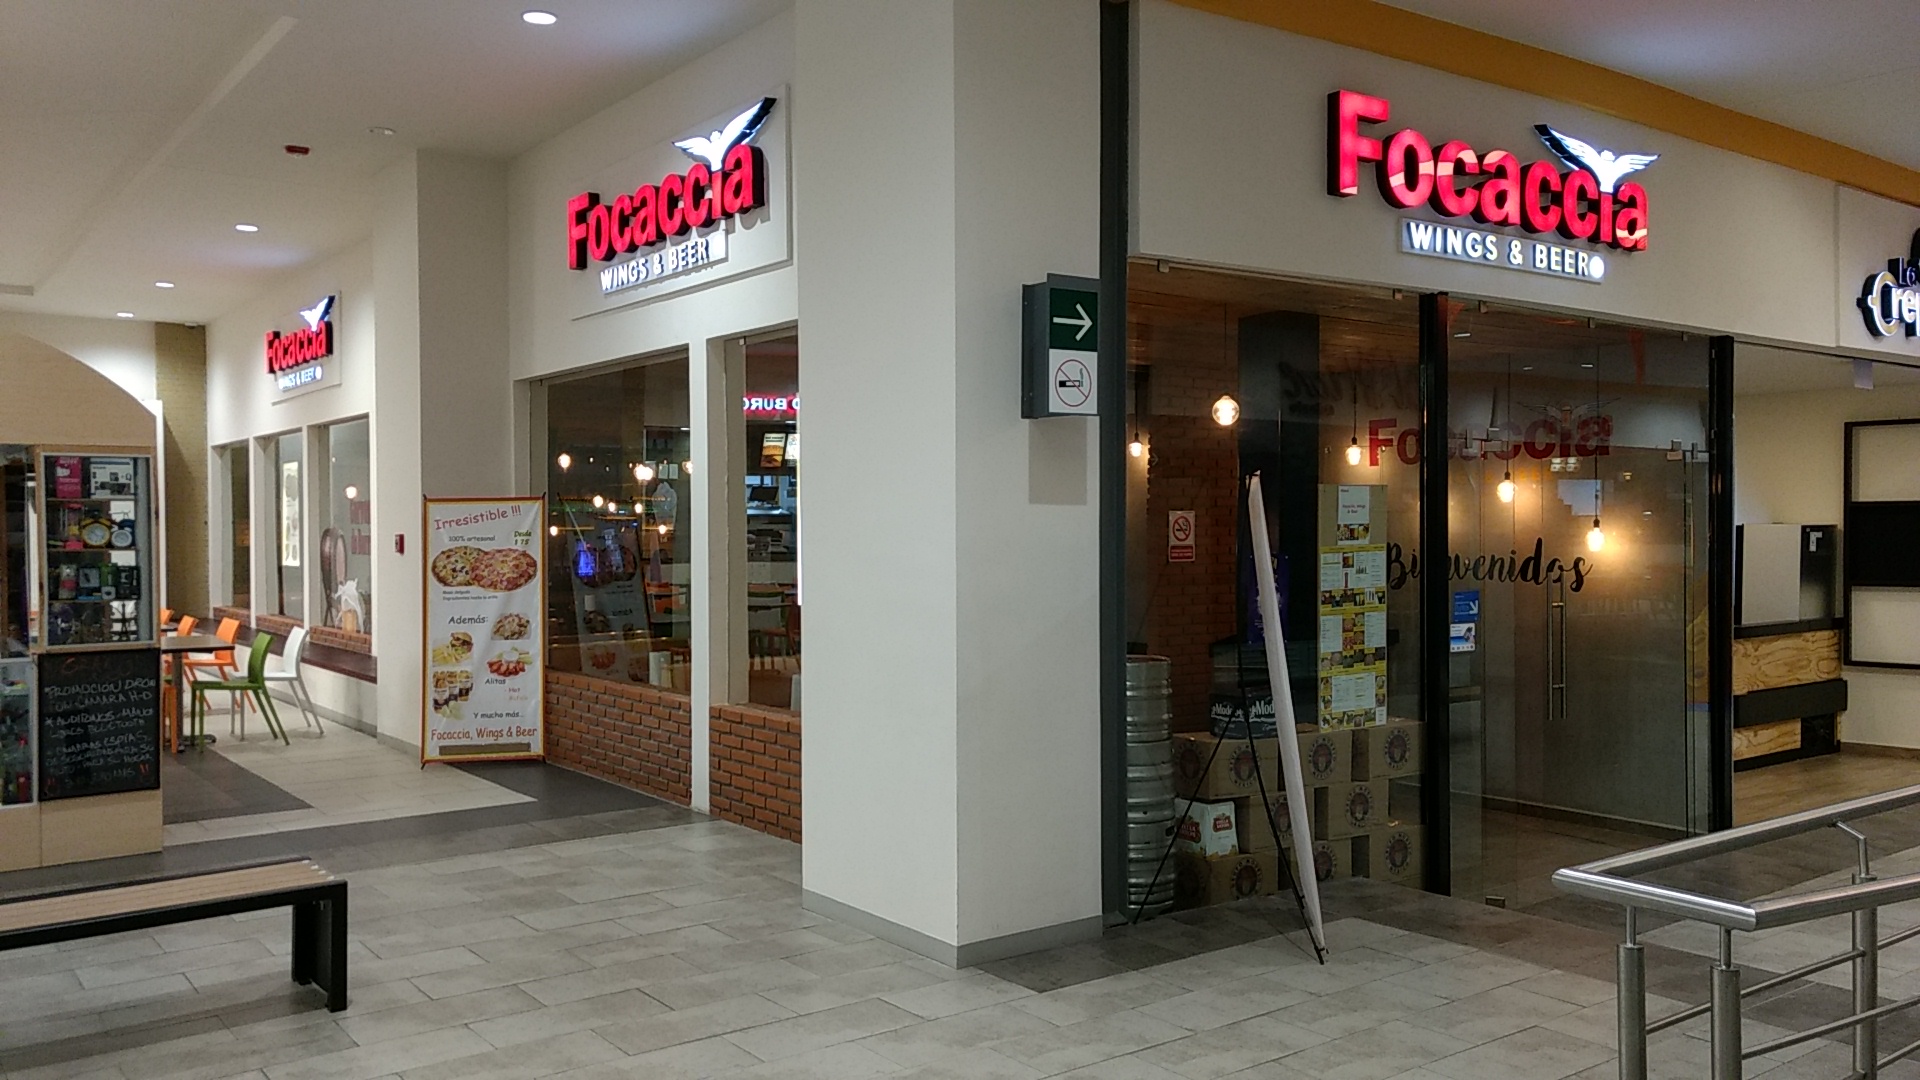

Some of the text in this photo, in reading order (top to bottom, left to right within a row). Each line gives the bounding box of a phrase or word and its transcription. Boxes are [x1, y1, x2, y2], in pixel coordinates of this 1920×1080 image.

[1327, 88, 1648, 252] Focaccia
[567, 143, 765, 271] Focaccia
[600, 237, 709, 291] WINGS & BEER
[1408, 221, 1589, 277] WINGS & BEER
[263, 320, 334, 374] Focaccia
[1369, 415, 1613, 468] Foccia
[434, 504, 521, 531] Irresistible !!!
[1387, 537, 1594, 593] Bivenidos
[448, 615, 489, 625] Además:
[430, 725, 538, 741] Focaccia, Wings & Beer
[480, 711, 504, 719] mucho
